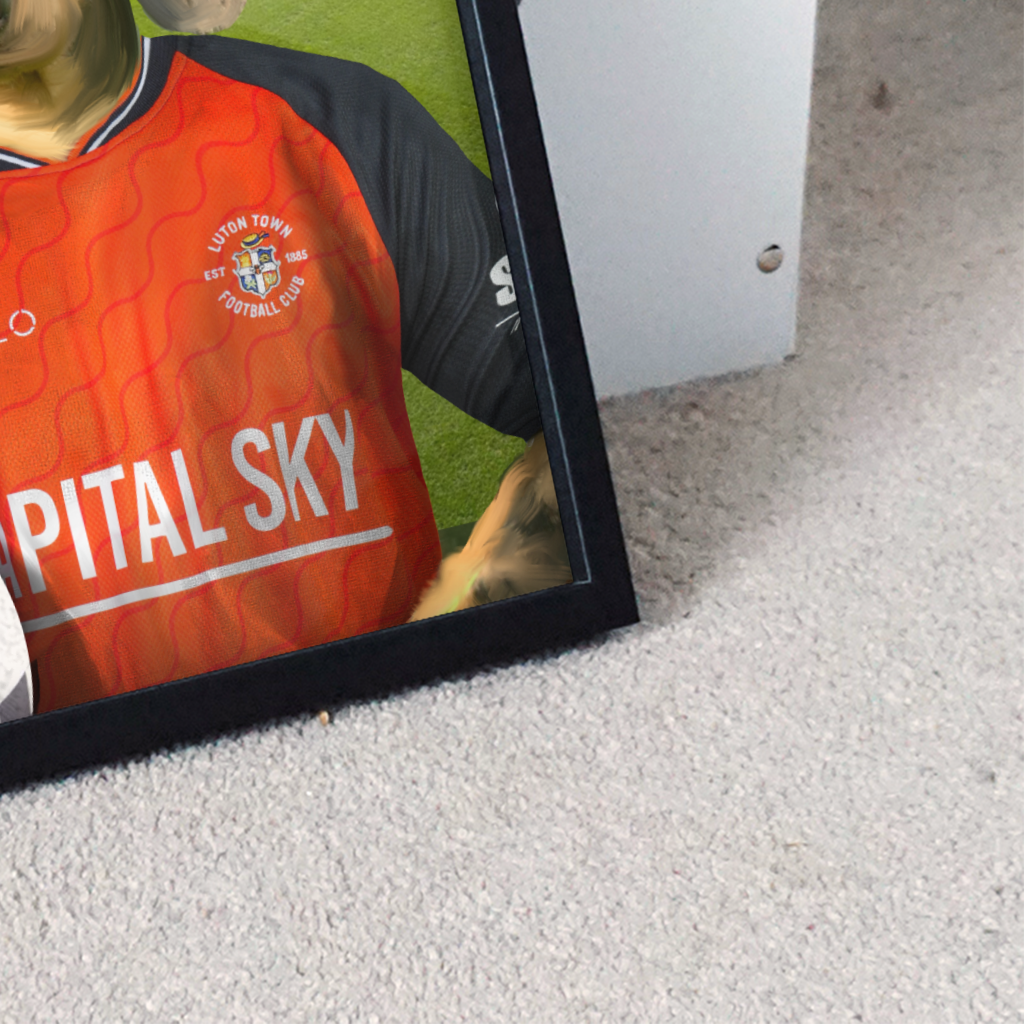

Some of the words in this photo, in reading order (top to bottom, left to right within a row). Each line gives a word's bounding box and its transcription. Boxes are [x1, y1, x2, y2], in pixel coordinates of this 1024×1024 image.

[207, 216, 248, 253] LUTON
[251, 214, 293, 239] TOWN
[204, 266, 226, 281] EST
[284, 249, 308, 263] 1885
[217, 290, 281, 318] FOOTBALL
[278, 275, 305, 307] CLUB
[230, 408, 359, 532] SKY
